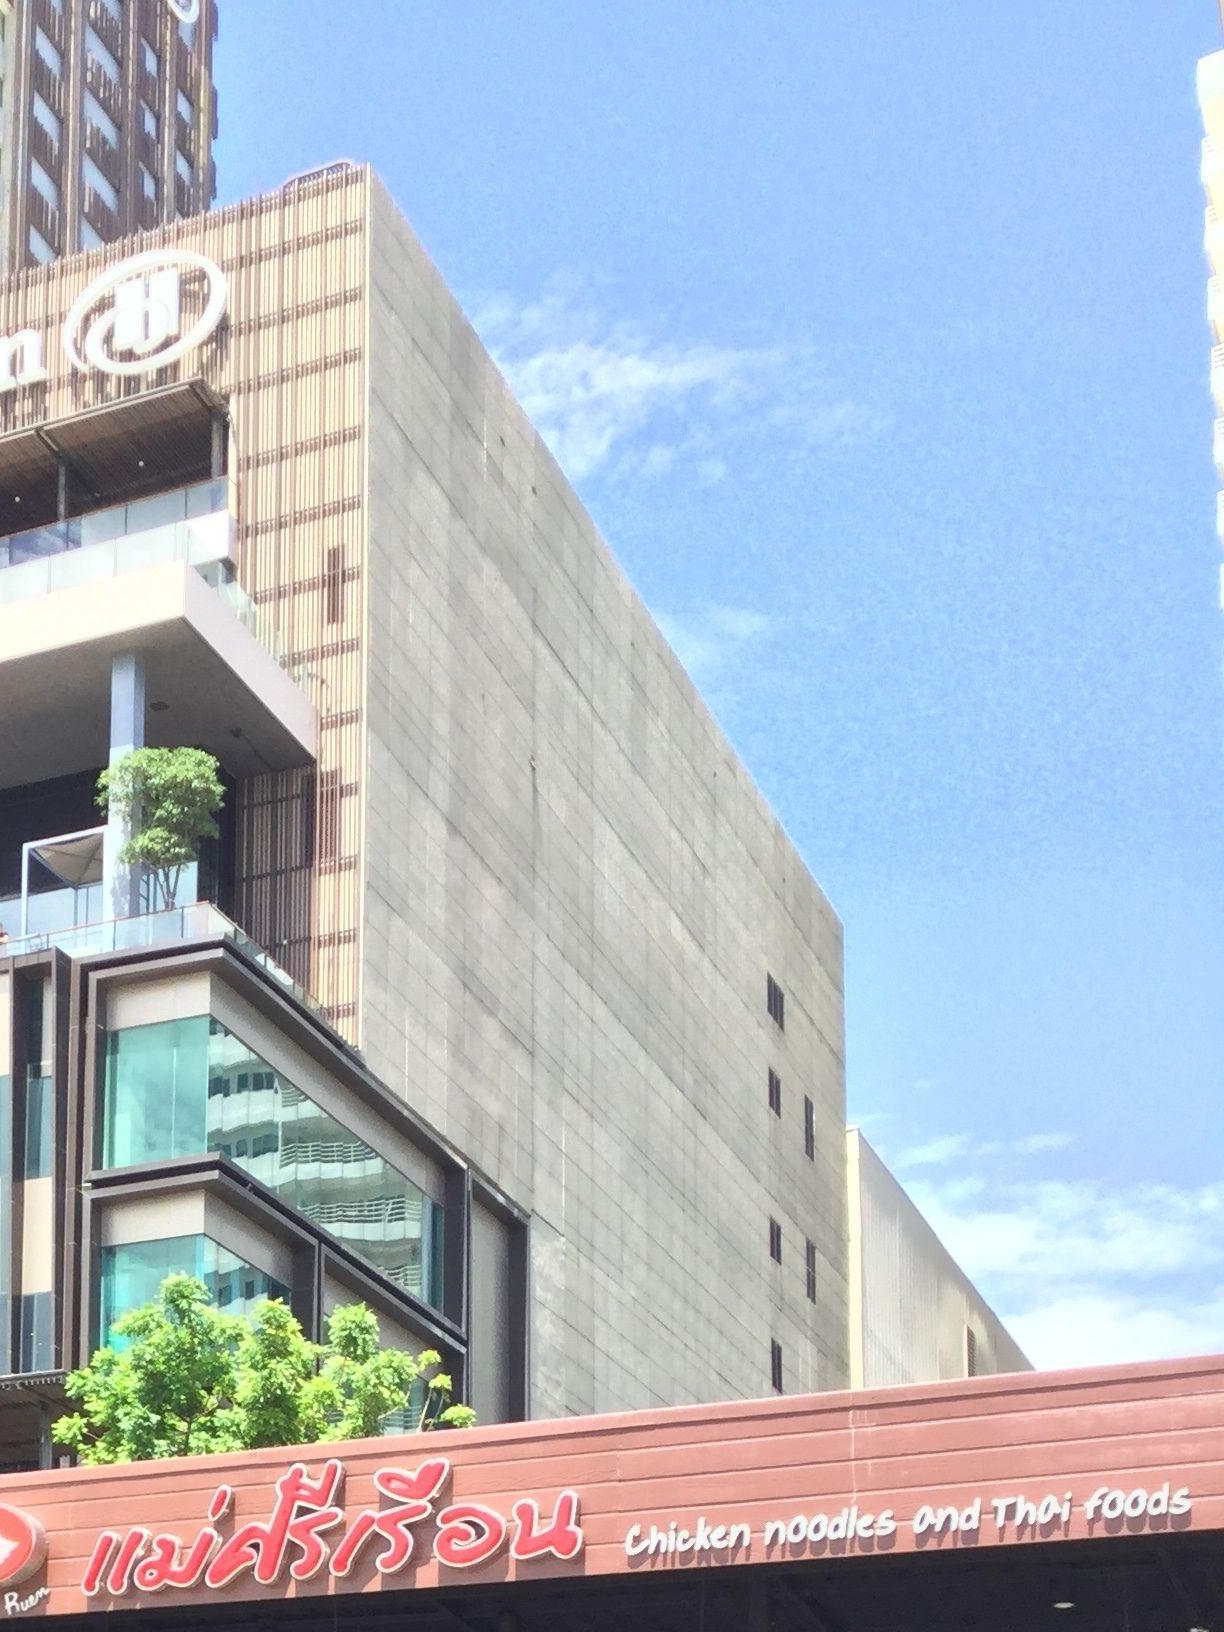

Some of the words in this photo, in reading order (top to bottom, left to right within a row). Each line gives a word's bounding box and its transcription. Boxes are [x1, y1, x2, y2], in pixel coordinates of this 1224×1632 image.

[80, 1457, 586, 1597] แม่ศรีเรือน
[625, 1516, 752, 1556] Chicken
[763, 1504, 897, 1546] noodles
[912, 1496, 982, 1534] and
[991, 1490, 1073, 1528] Thai
[1083, 1481, 1193, 1520] foods
